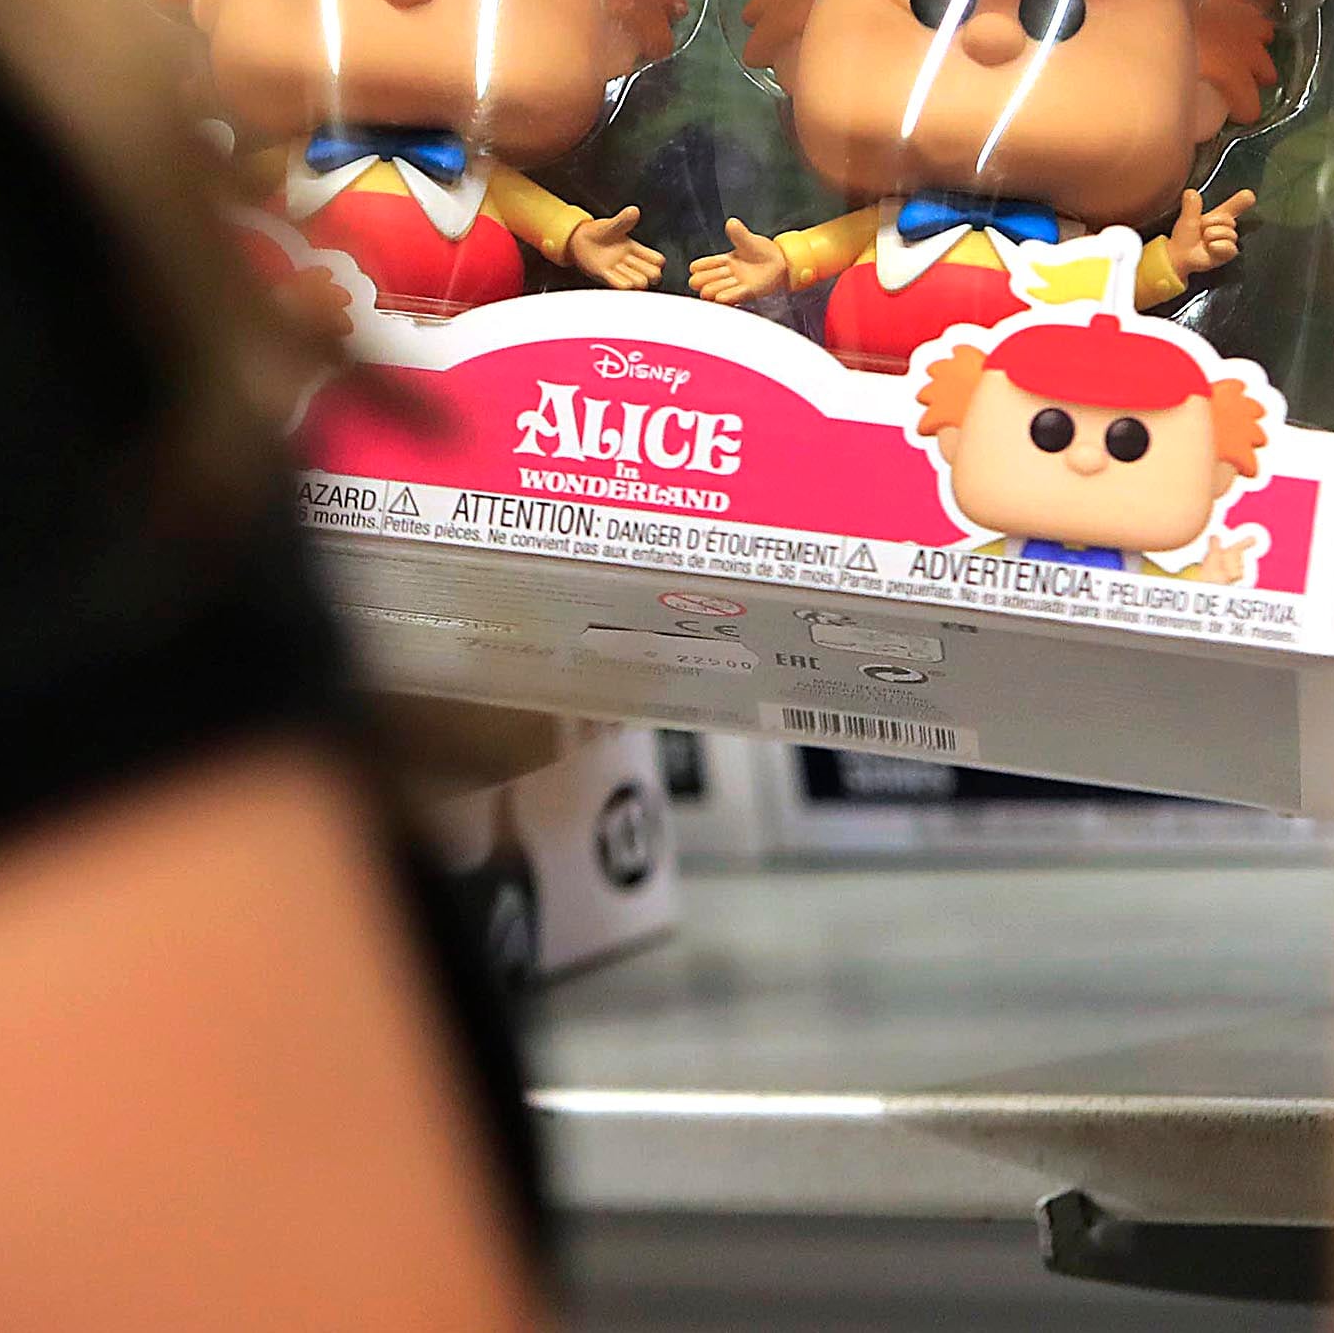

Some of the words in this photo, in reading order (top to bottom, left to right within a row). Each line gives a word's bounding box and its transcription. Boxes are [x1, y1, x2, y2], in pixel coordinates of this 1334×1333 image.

[513, 379, 745, 477] ALICE
[518, 467, 732, 514] WONDERLAND
[615, 461, 641, 481] in
[298, 482, 383, 512] AZARD.
[313, 509, 380, 530] months.
[452, 492, 602, 540] ATTENTION:
[607, 517, 681, 548] DANGER
[384, 515, 431, 537] Petites
[433, 522, 483, 543] pièces.
[487, 529, 508, 546] Ne
[510, 532, 570, 553] convient
[572, 540, 599, 559] pas
[602, 543, 628, 558] aux
[632, 545, 684, 567] enfants
[687, 552, 705, 569] de
[709, 556, 752, 575] moins
[756, 560, 775, 577] de
[778, 562, 796, 580] 36
[908, 549, 1102, 601] ADVERTENCIA:
[1107, 582, 1189, 613] PELIGRO
[1193, 591, 1220, 617] DE
